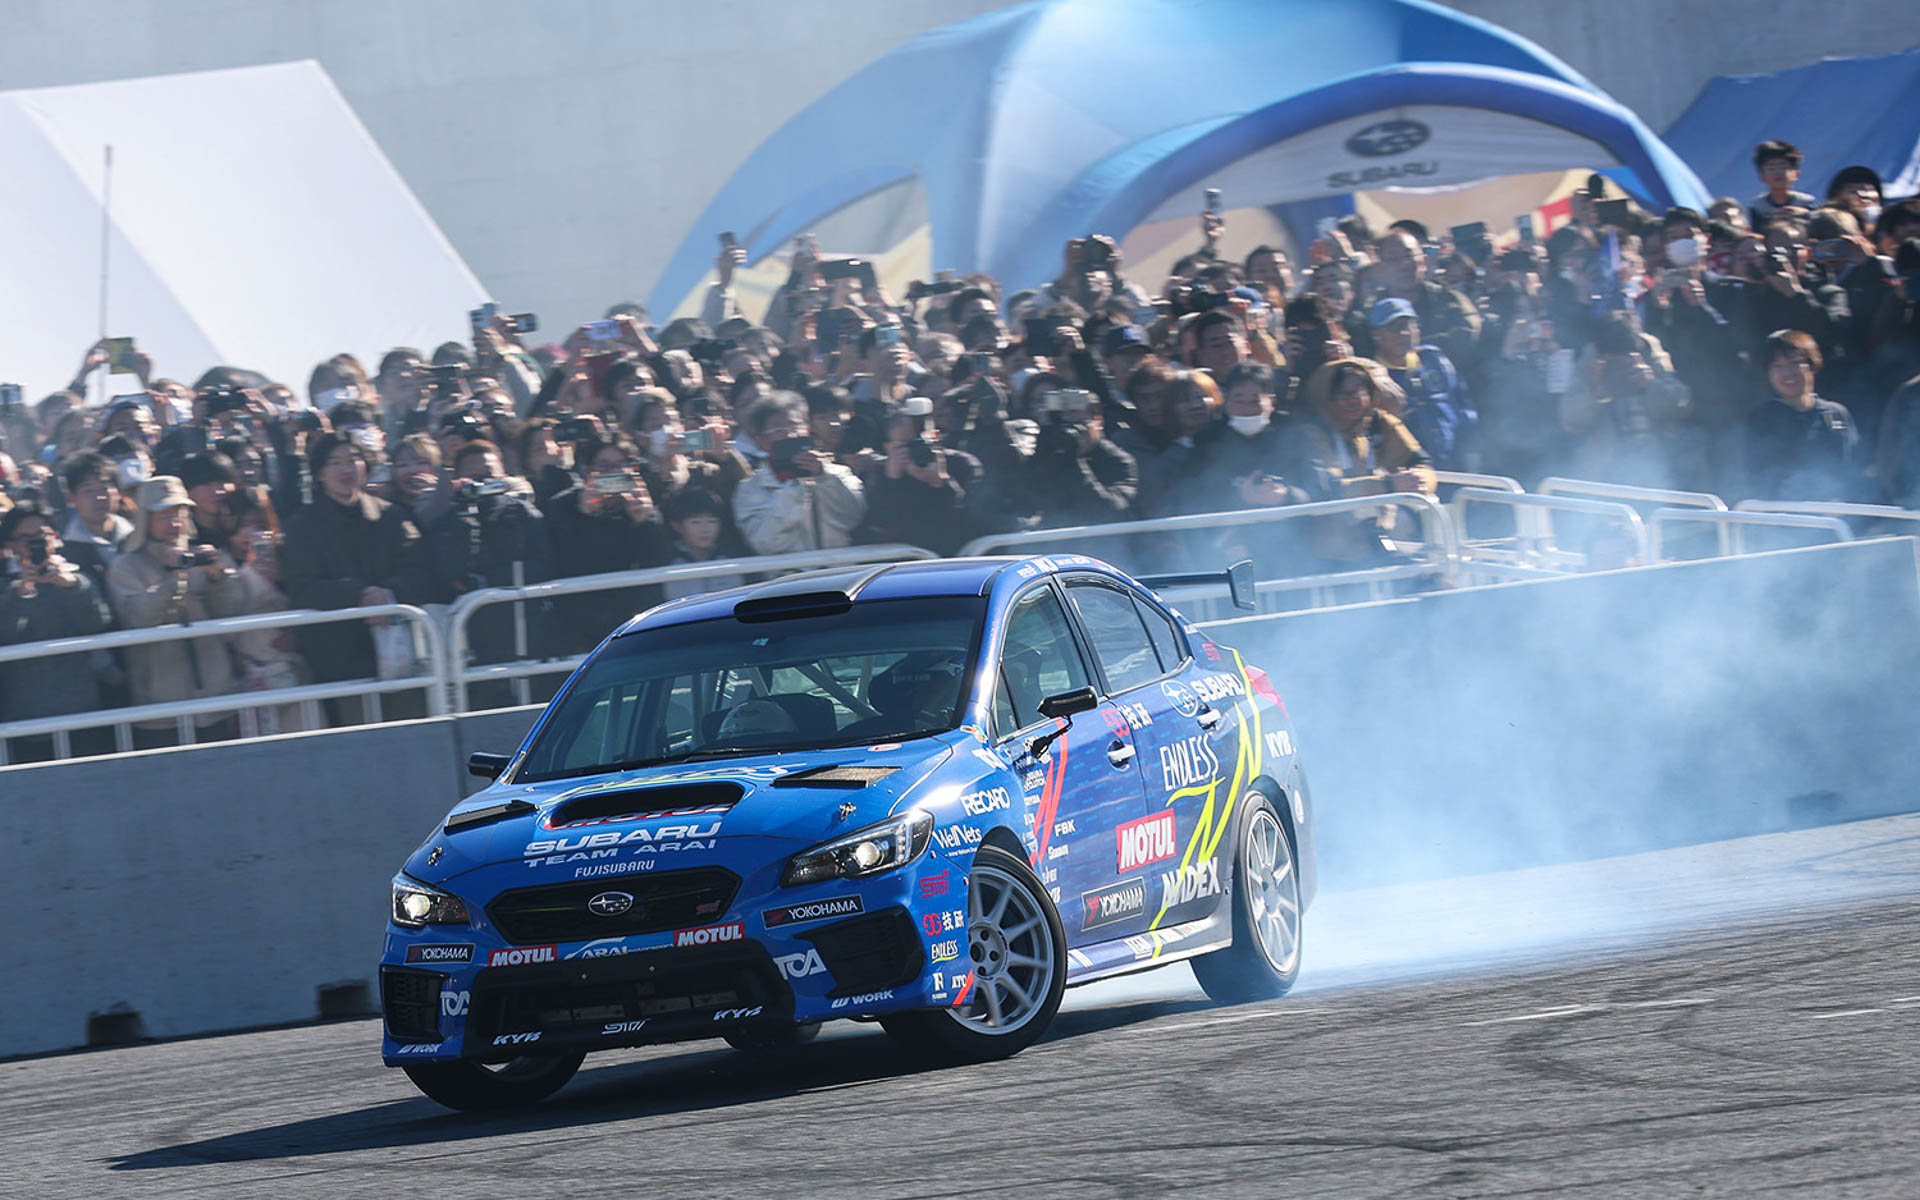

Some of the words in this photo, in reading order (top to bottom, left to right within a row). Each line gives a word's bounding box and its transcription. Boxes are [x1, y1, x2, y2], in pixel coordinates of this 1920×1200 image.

[1327, 160, 1440, 188] SUBARU
[1190, 672, 1245, 702] SUBARU
[1160, 733, 1219, 792] ENDLESS
[961, 786, 1010, 816] RECARO
[524, 821, 722, 856] SUBARU
[1119, 816, 1175, 869] MOTUL
[524, 846, 618, 868] TEAM
[634, 839, 716, 855] ARAI
[574, 859, 655, 878] FUJISUBARU
[788, 899, 858, 920] YOKOHAMA
[1099, 887, 1142, 918] YOKOHAMA
[677, 924, 743, 948] MOTUL
[421, 947, 469, 960] YOKOHAMA
[491, 947, 555, 967] MOTUL
[581, 946, 628, 960] ARAI
[931, 940, 958, 960] ENDLESS
[851, 989, 894, 1005] WORK
